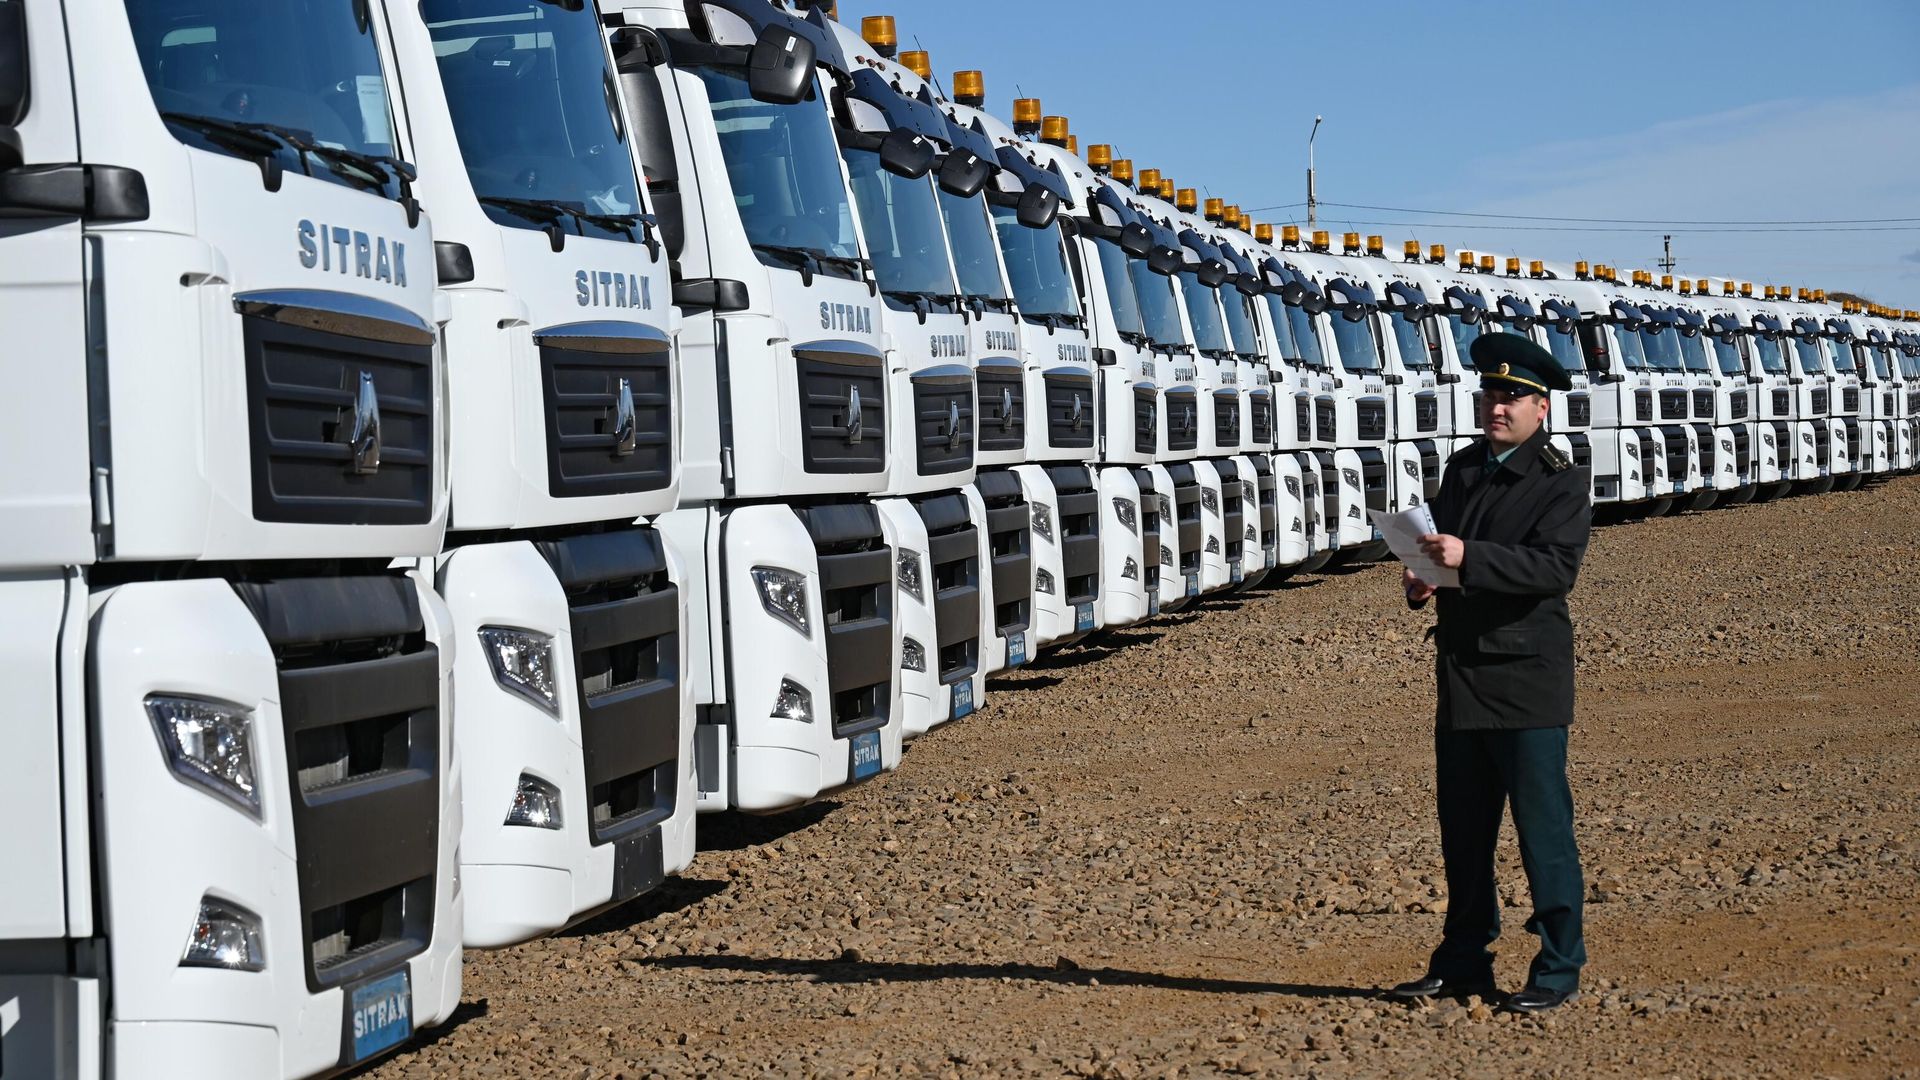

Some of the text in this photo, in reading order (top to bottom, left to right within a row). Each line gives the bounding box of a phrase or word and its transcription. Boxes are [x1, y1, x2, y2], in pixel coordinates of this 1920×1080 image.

[298, 219, 407, 287] SITRAK
[575, 270, 652, 310] SITRAK
[820, 301, 872, 334] SITRAK
[930, 335, 966, 357] SITRAK
[985, 330, 1016, 351] SITRAK
[1057, 343, 1087, 362] SITRAK
[855, 744, 880, 766] SITRAK
[354, 993, 408, 1039] SITRAK
